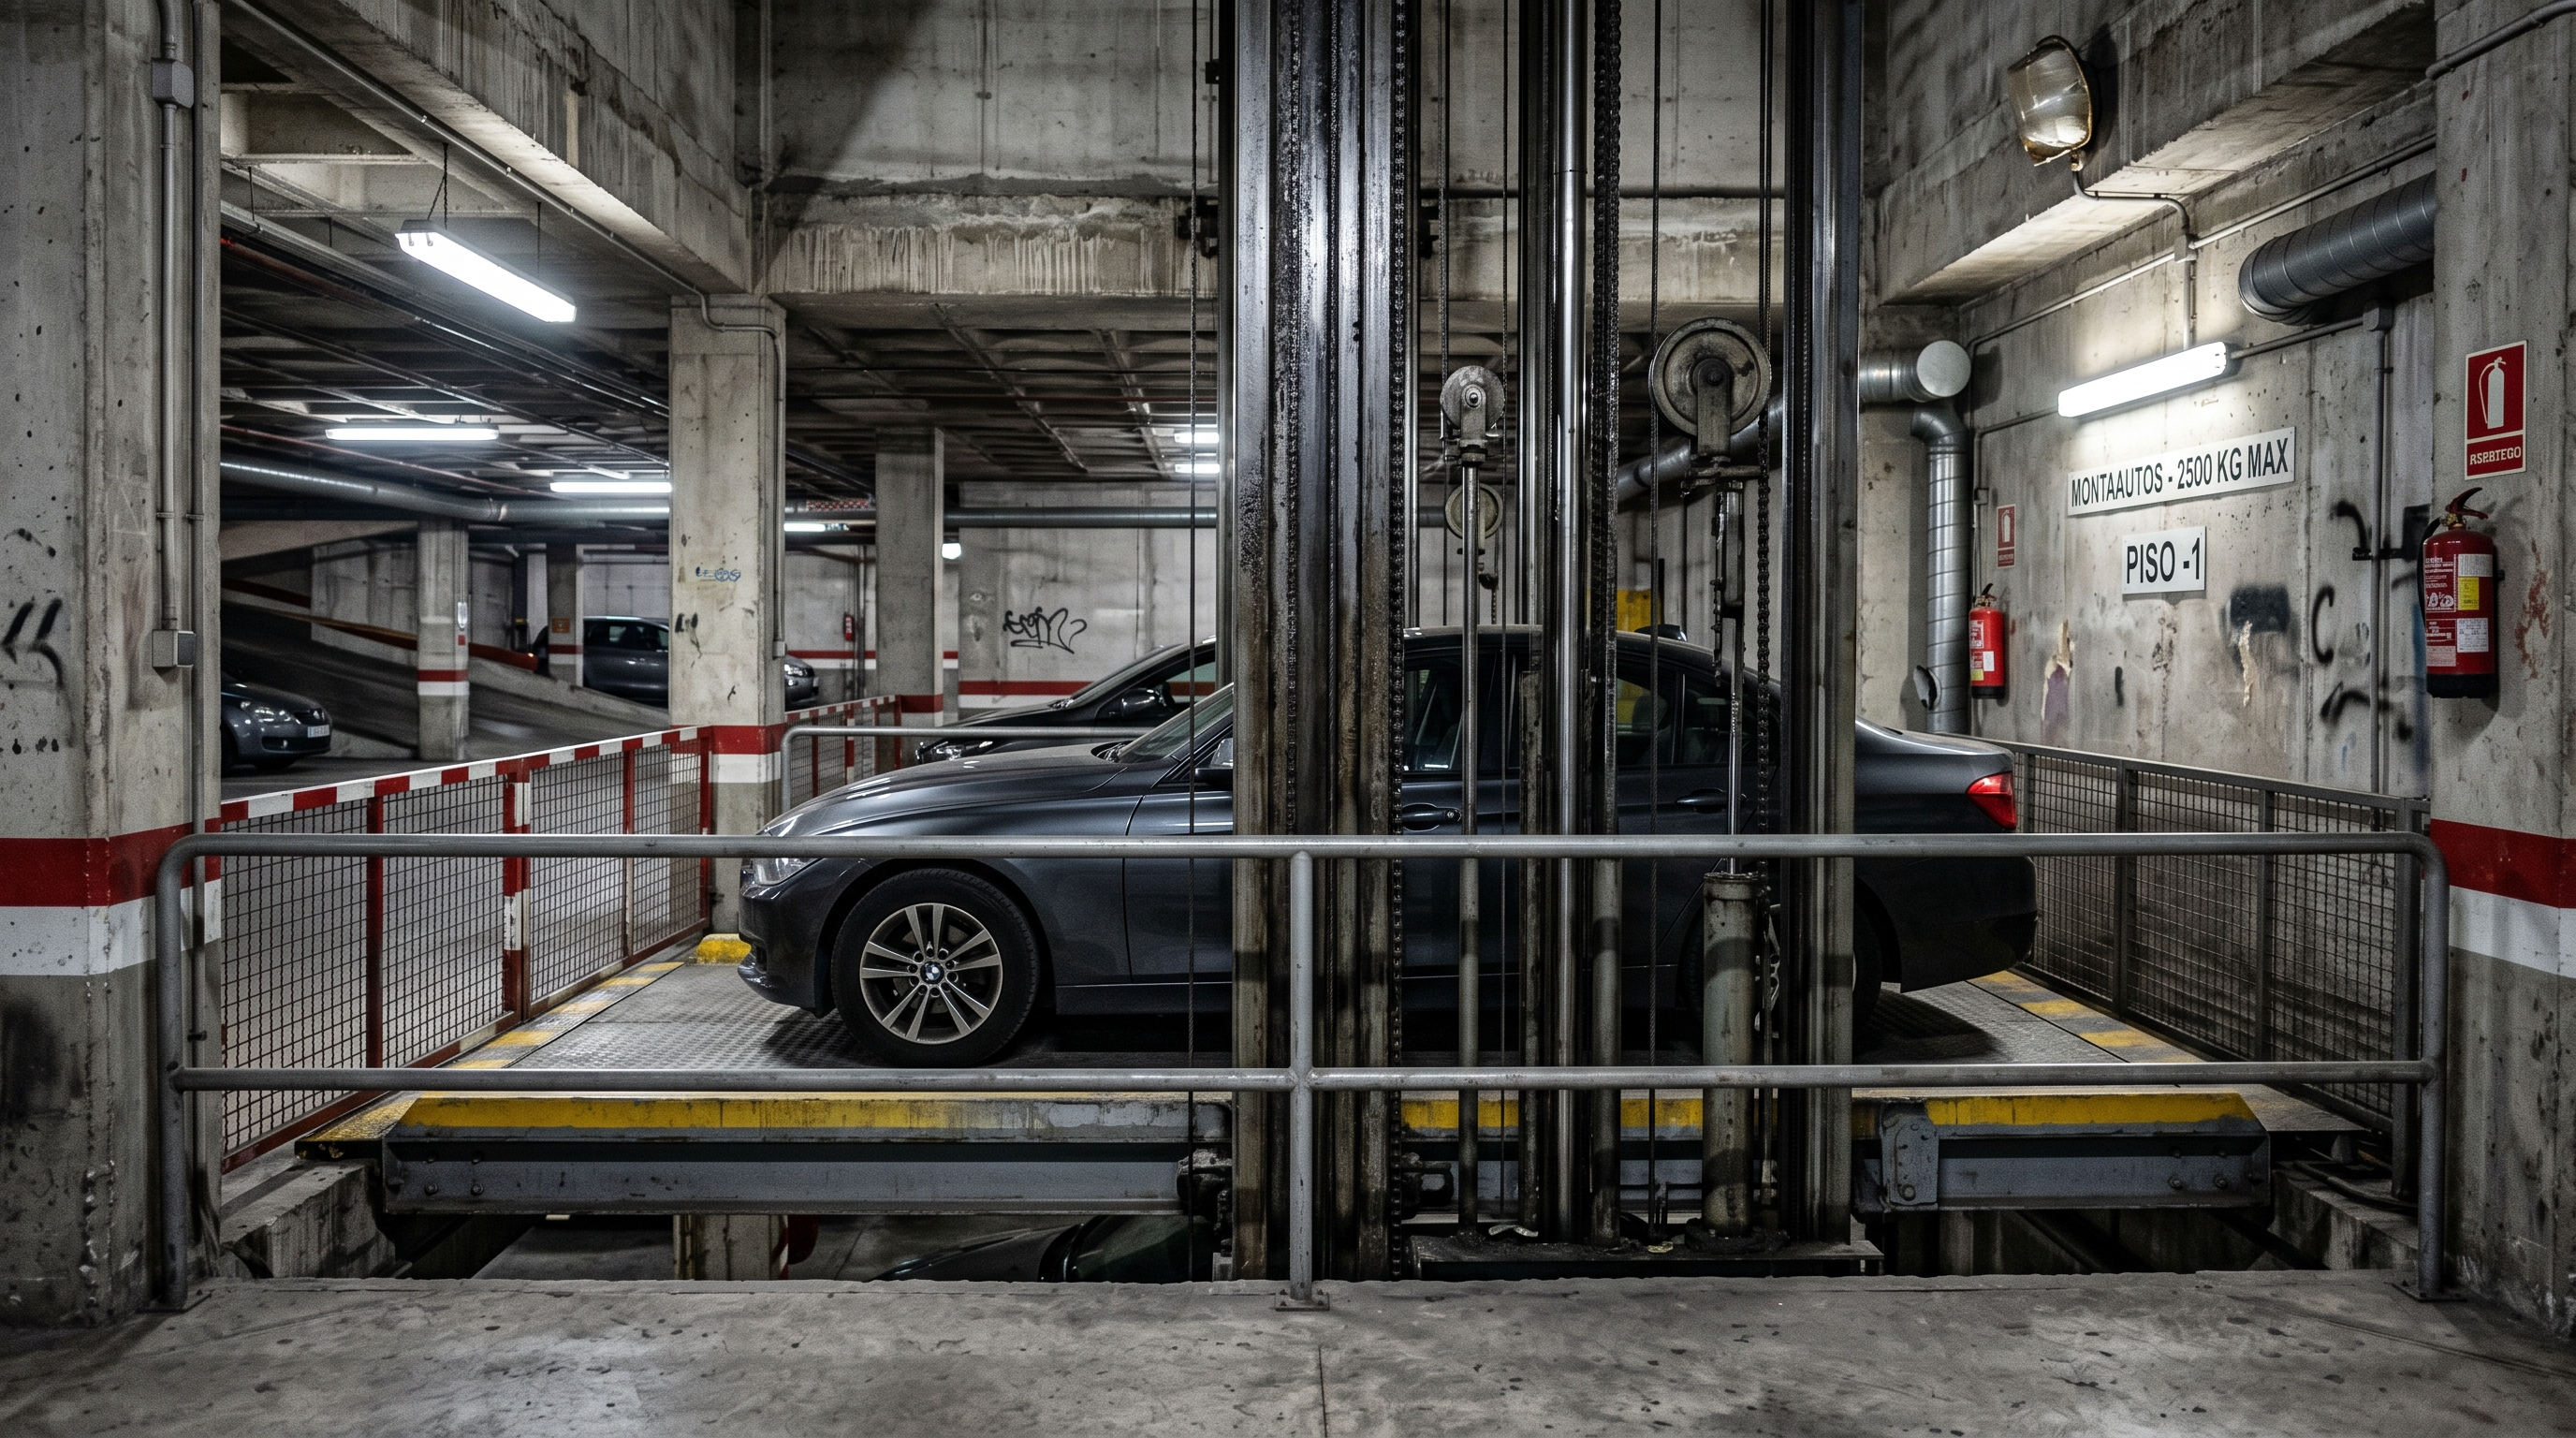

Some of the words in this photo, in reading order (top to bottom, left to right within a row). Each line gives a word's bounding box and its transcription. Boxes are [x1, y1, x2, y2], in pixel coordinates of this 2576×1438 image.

[2071, 462, 2163, 507] MONTAAUTOS
[2177, 453, 2213, 490] 2500
[2217, 447, 2242, 483] KG
[2247, 437, 2289, 478] MAX
[2127, 540, 2175, 584] PISO
[2183, 536, 2201, 580] -1
